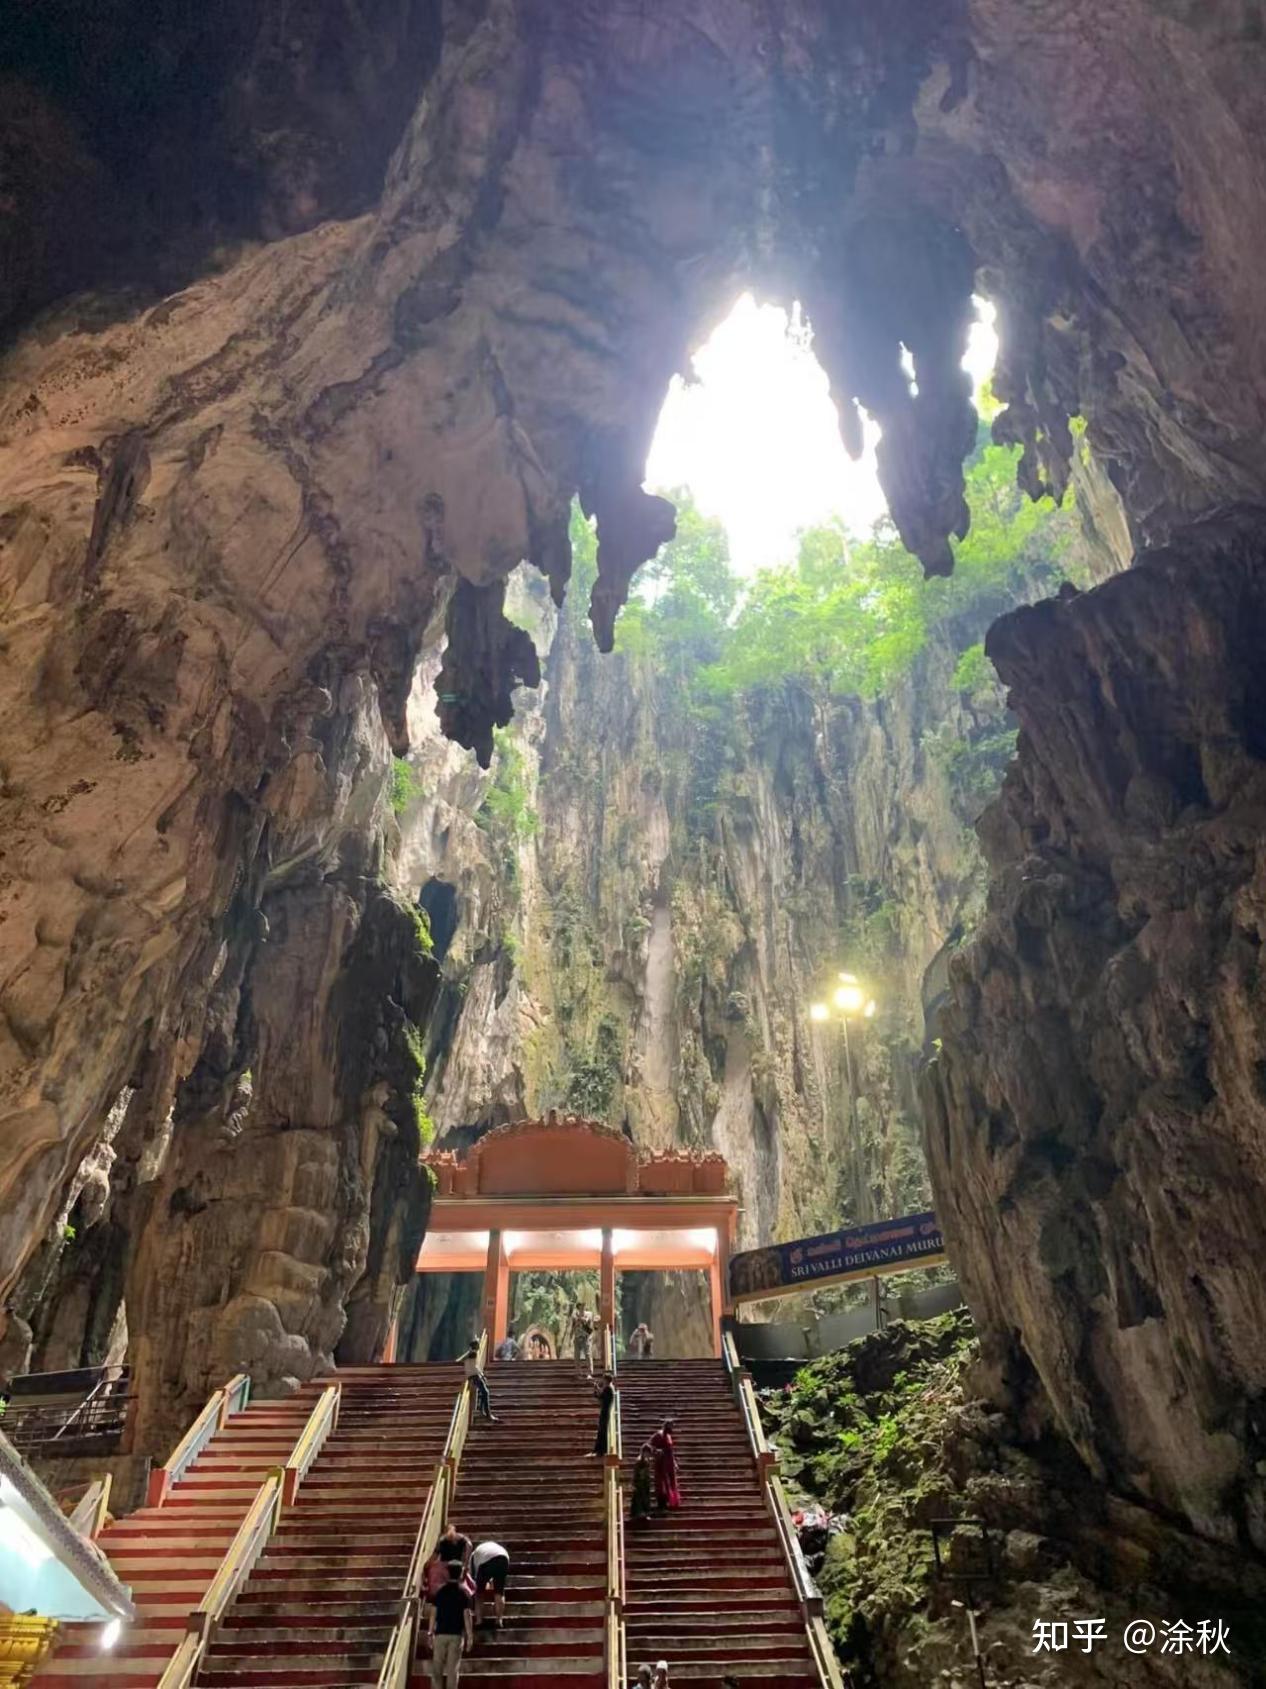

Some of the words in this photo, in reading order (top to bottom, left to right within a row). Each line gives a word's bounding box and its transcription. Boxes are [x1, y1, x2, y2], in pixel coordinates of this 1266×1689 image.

[791, 1262, 809, 1278] SRI
[811, 1257, 843, 1274] VALLI
[845, 1245, 903, 1266] DEIVANAI
